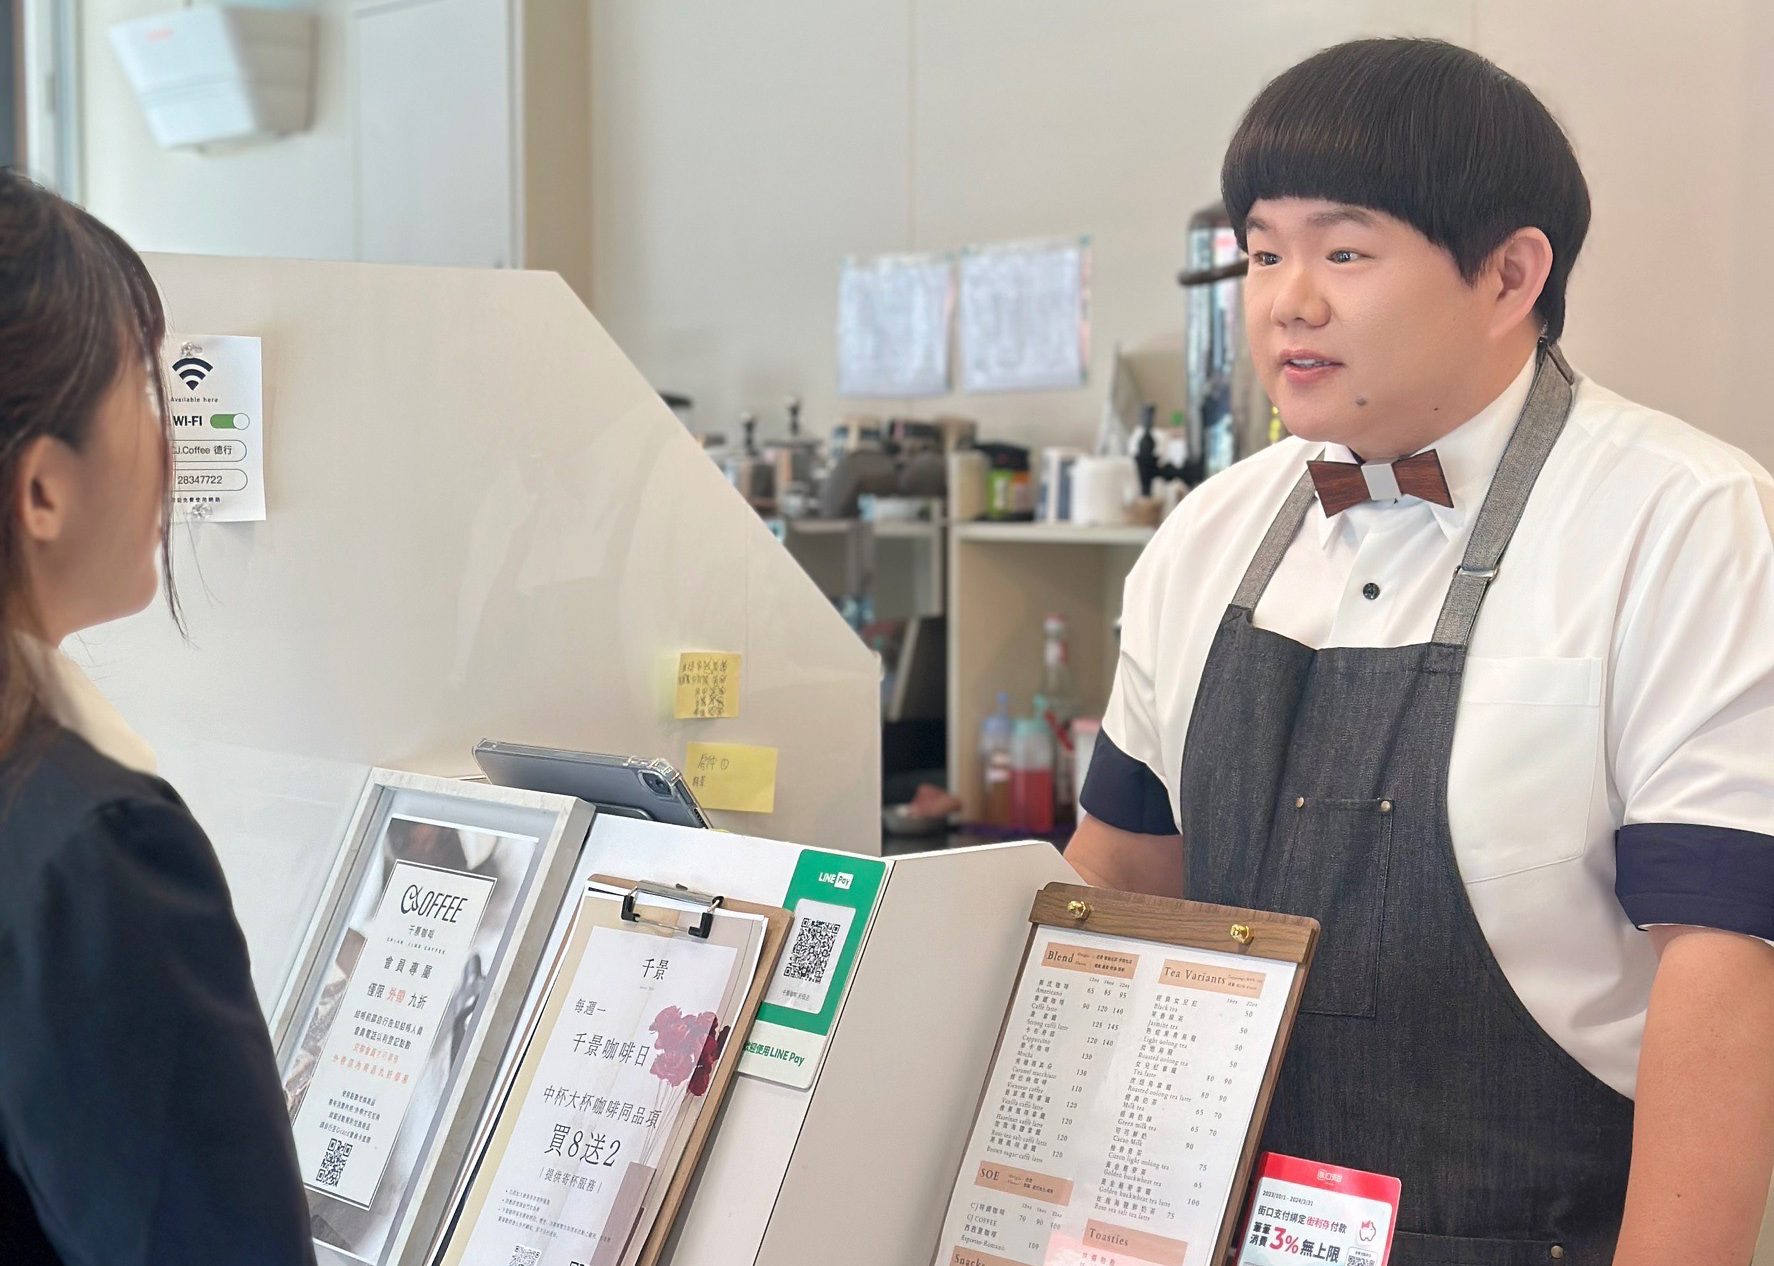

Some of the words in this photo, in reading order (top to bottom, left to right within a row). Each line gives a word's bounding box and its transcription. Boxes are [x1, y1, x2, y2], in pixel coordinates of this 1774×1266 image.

[173, 416, 202, 426] WI-FI
[214, 445, 232, 455] 德行
[178, 476, 223, 484] 28347722
[818, 872, 836, 884] LINE
[837, 875, 850, 886] Pay
[1048, 950, 1074, 963] Blend
[642, 958, 668, 980] 千景
[1164, 967, 1181, 978] Tea
[1185, 970, 1226, 985] Variants
[408, 993, 428, 1009] 九折
[575, 998, 606, 1016] 每週一
[573, 1033, 650, 1066] 千景咖啡日
[770, 1047, 790, 1061] LINE
[788, 1052, 805, 1067] Pay
[544, 1084, 662, 1128] 中杯大杯咖啡同品項
[1209, 1129, 1217, 1137] 70
[544, 1124, 621, 1167] 買8送2
[1186, 1142, 1194, 1150] 90
[1052, 1150, 1063, 1158] 120
[980, 1168, 1000, 1181] SOE
[1187, 1198, 1200, 1207] 100
[974, 1216, 998, 1227] COFFEE
[1089, 1228, 1129, 1247] Toasties
[1249, 1234, 1268, 1248] 消費
[1269, 1226, 1300, 1254] 3%
[1300, 1239, 1341, 1263] 無上限
